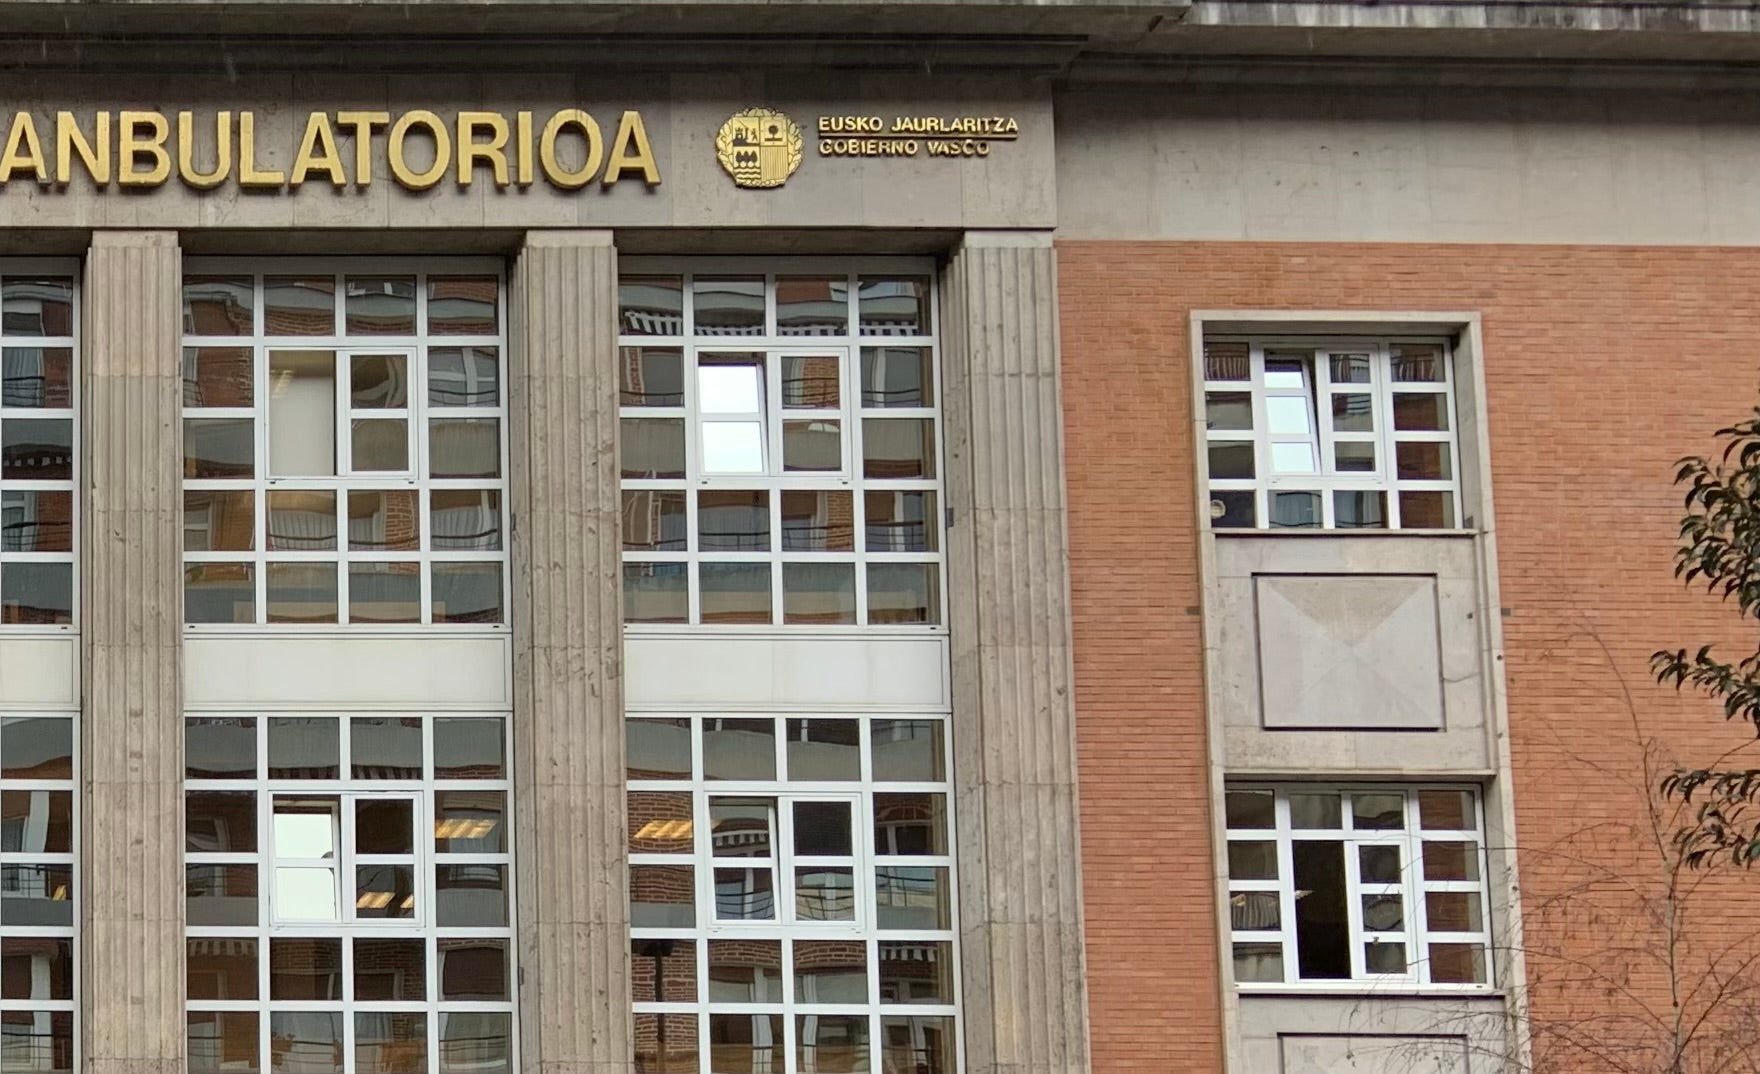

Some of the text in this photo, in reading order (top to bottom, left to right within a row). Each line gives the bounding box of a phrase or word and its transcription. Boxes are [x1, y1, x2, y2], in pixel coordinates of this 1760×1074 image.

[818, 116, 1018, 132] EUSKO JAURLARITZA
[819, 139, 990, 156] GOBIERNO VASCO
